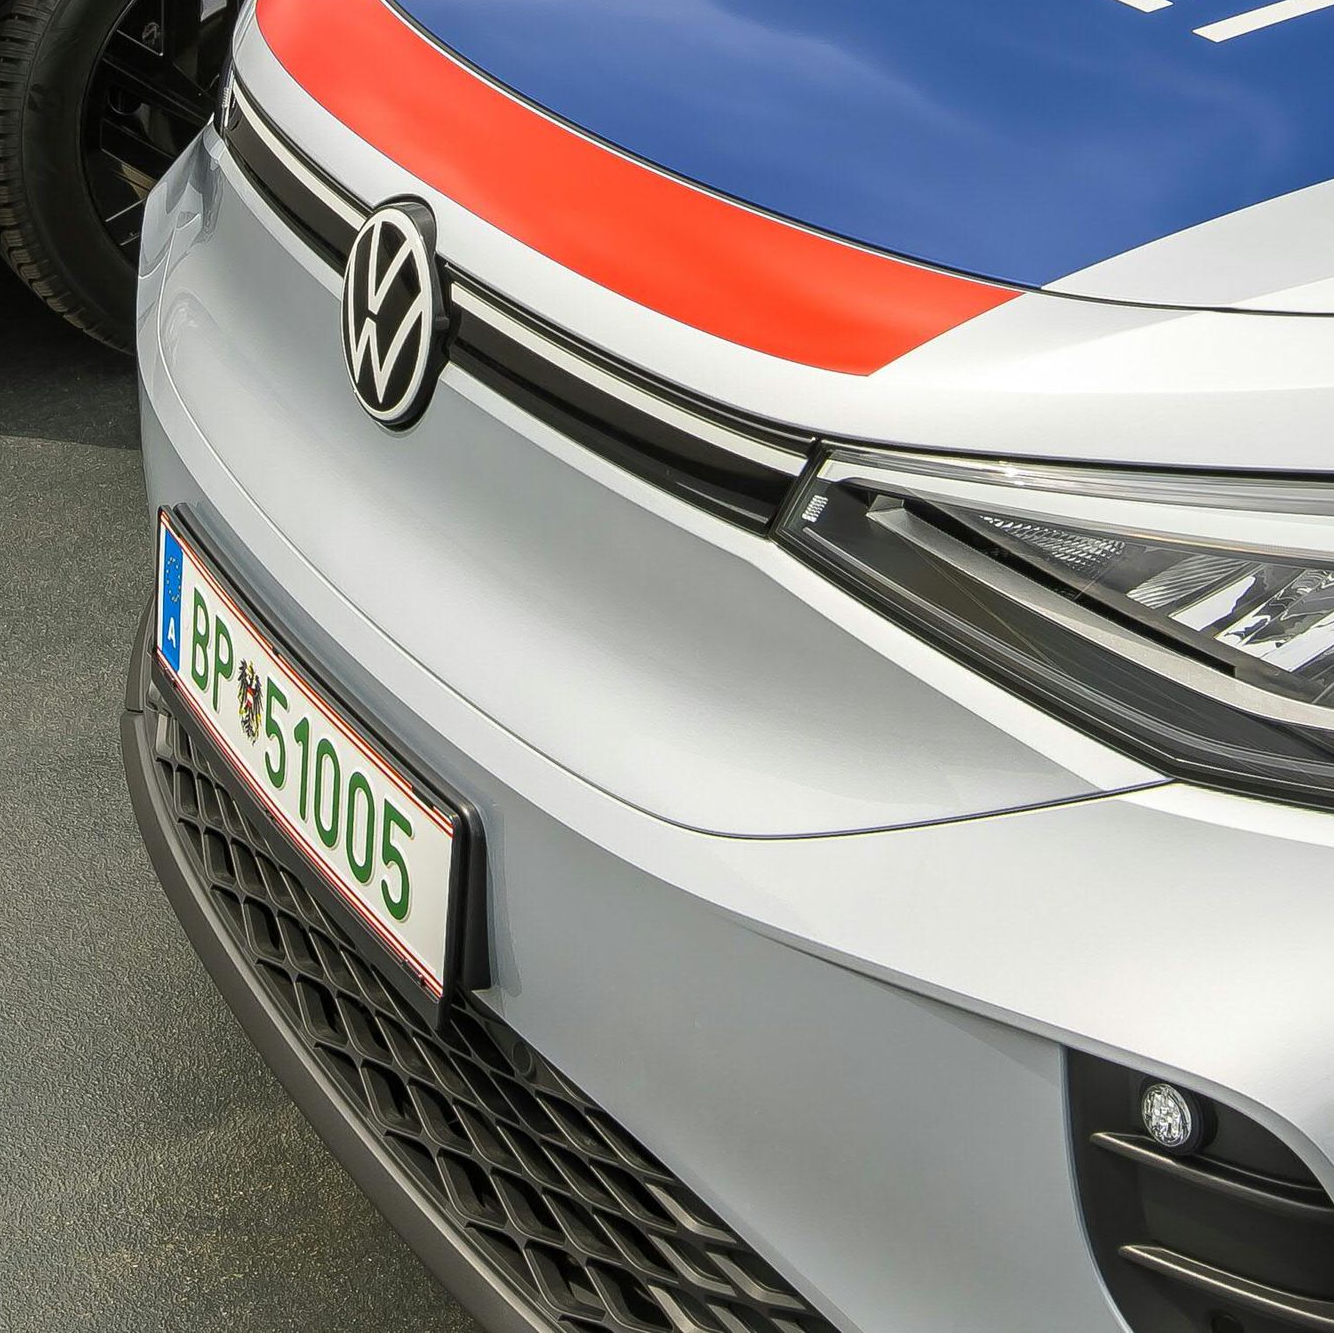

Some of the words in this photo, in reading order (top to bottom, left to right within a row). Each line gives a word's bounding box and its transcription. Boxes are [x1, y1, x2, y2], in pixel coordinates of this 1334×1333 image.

[166, 618, 177, 649] A
[192, 586, 234, 713] BP
[264, 678, 414, 922] 51005
